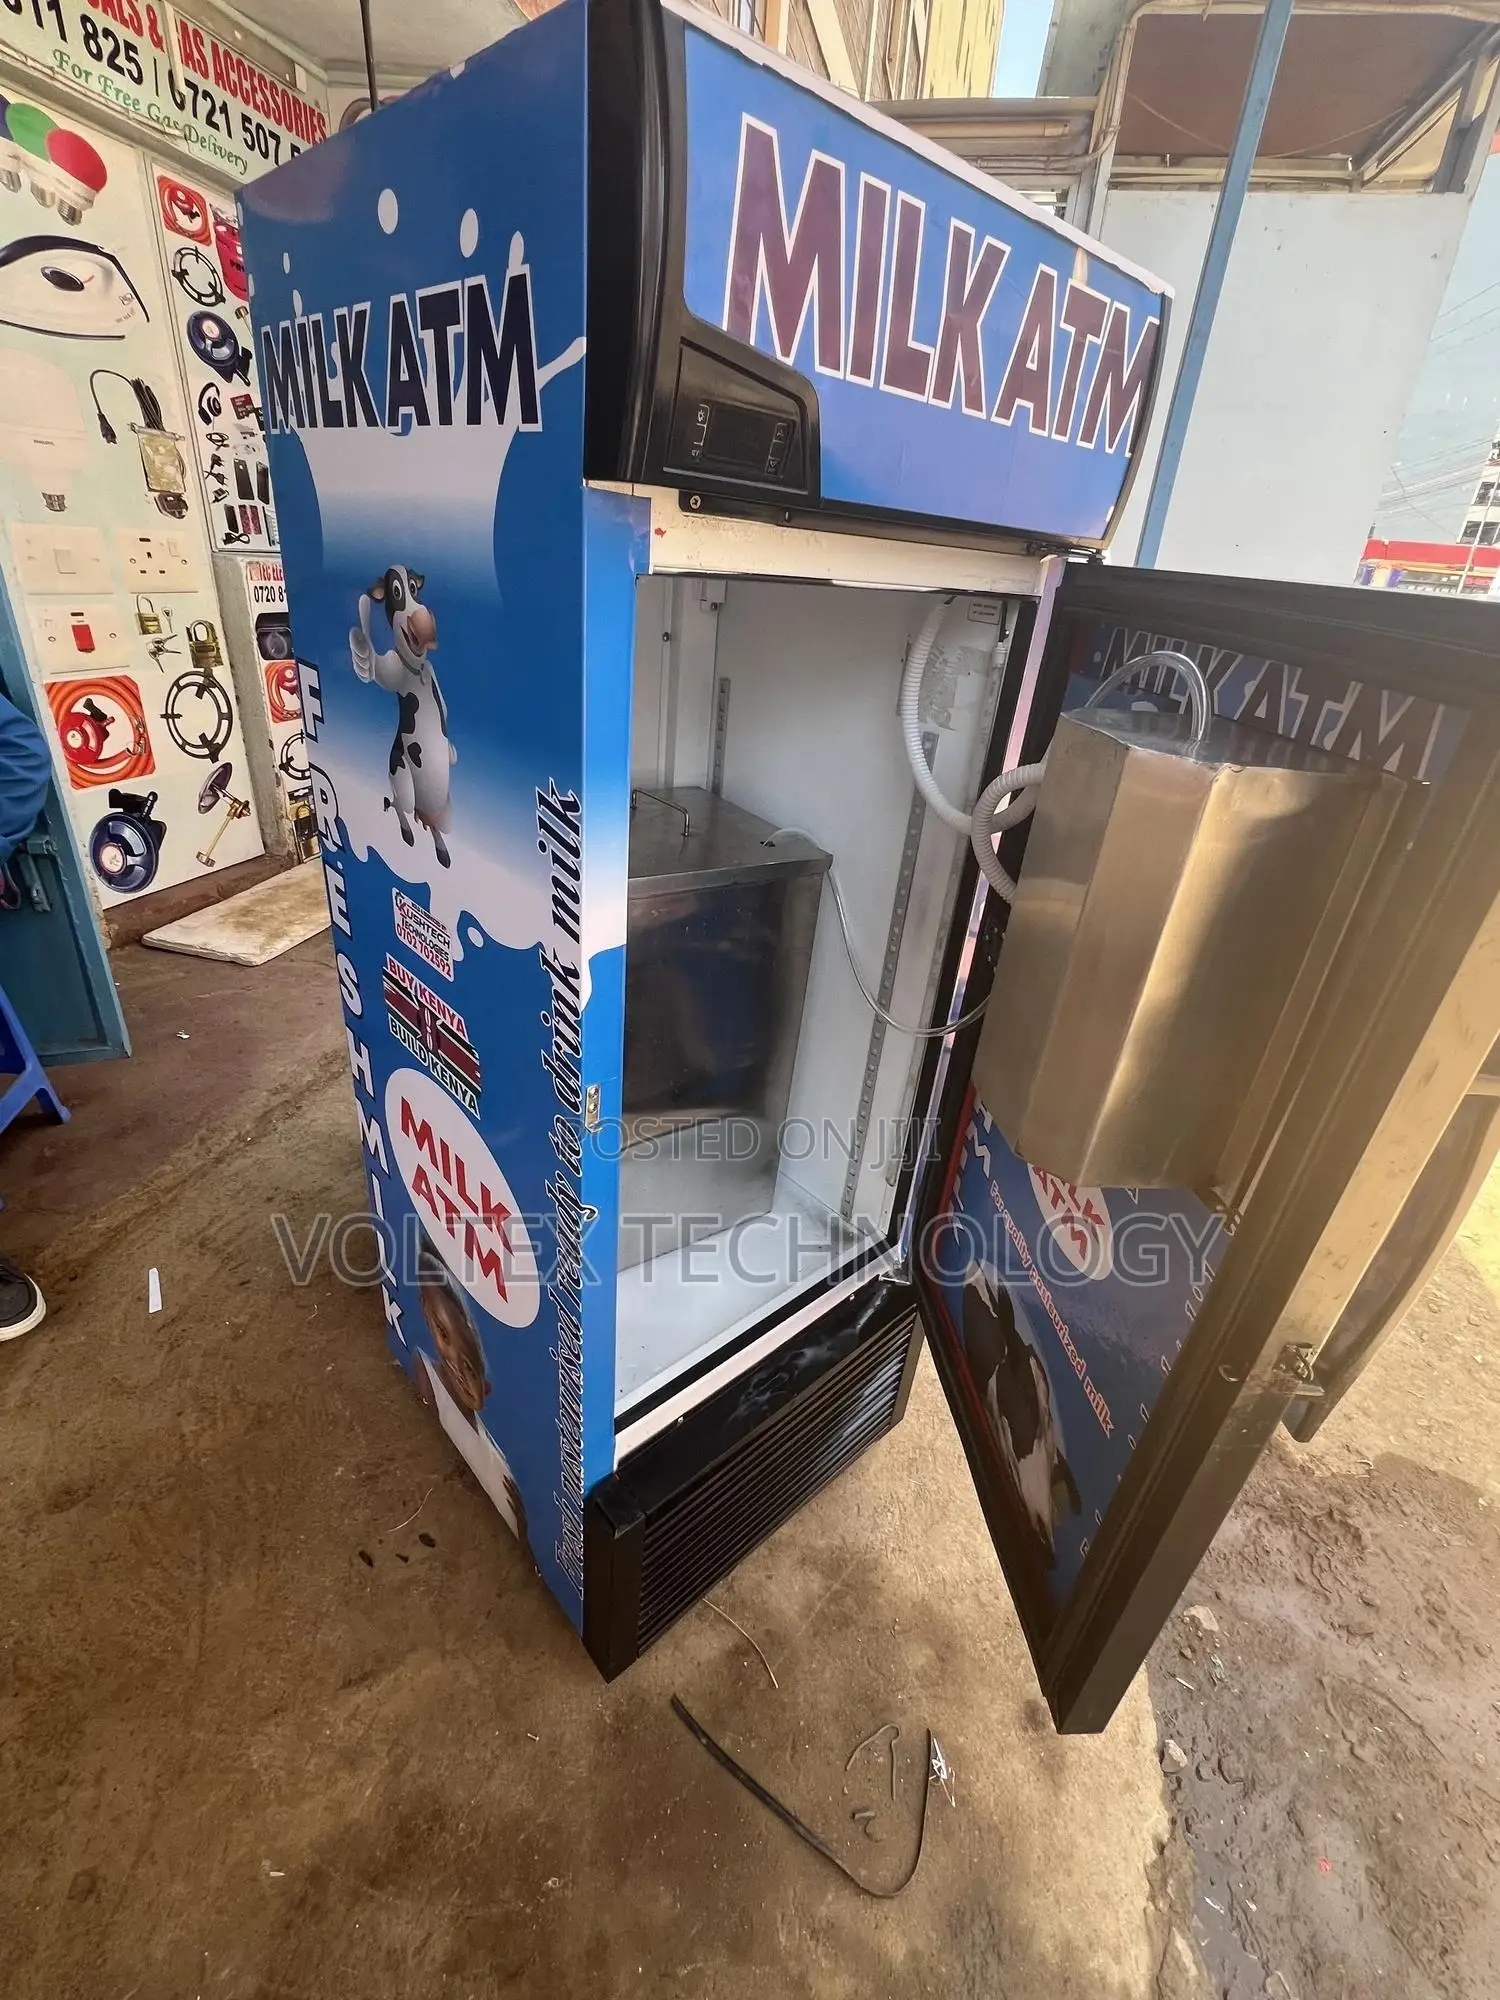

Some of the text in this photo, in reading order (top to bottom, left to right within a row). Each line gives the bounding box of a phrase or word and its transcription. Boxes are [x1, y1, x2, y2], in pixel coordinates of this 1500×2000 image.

[53, 48, 93, 84] For
[98, 74, 141, 111] Free
[183, 123, 248, 176] Delivery
[80, 14, 143, 86] 825
[242, 112, 281, 167] 507
[178, 17, 209, 80] AS
[211, 40, 327, 145] ACCESSORIES
[261, 264, 542, 434] MILK ATM
[723, 112, 1160, 457] MILK ATM
[254, 586, 276, 603] 0720
[297, 657, 375, 1099] FRESH
[535, 777, 583, 944] milk
[389, 958, 466, 1038] BUY KENYA
[539, 947, 583, 1114] drink
[390, 1017, 479, 1118] BUILD KENYA
[402, 1095, 515, 1258] MILK
[548, 1114, 583, 1177] to
[412, 1163, 508, 1304] ATM
[545, 1171, 598, 1289] ready
[1084, 1376, 1115, 1439] milk
